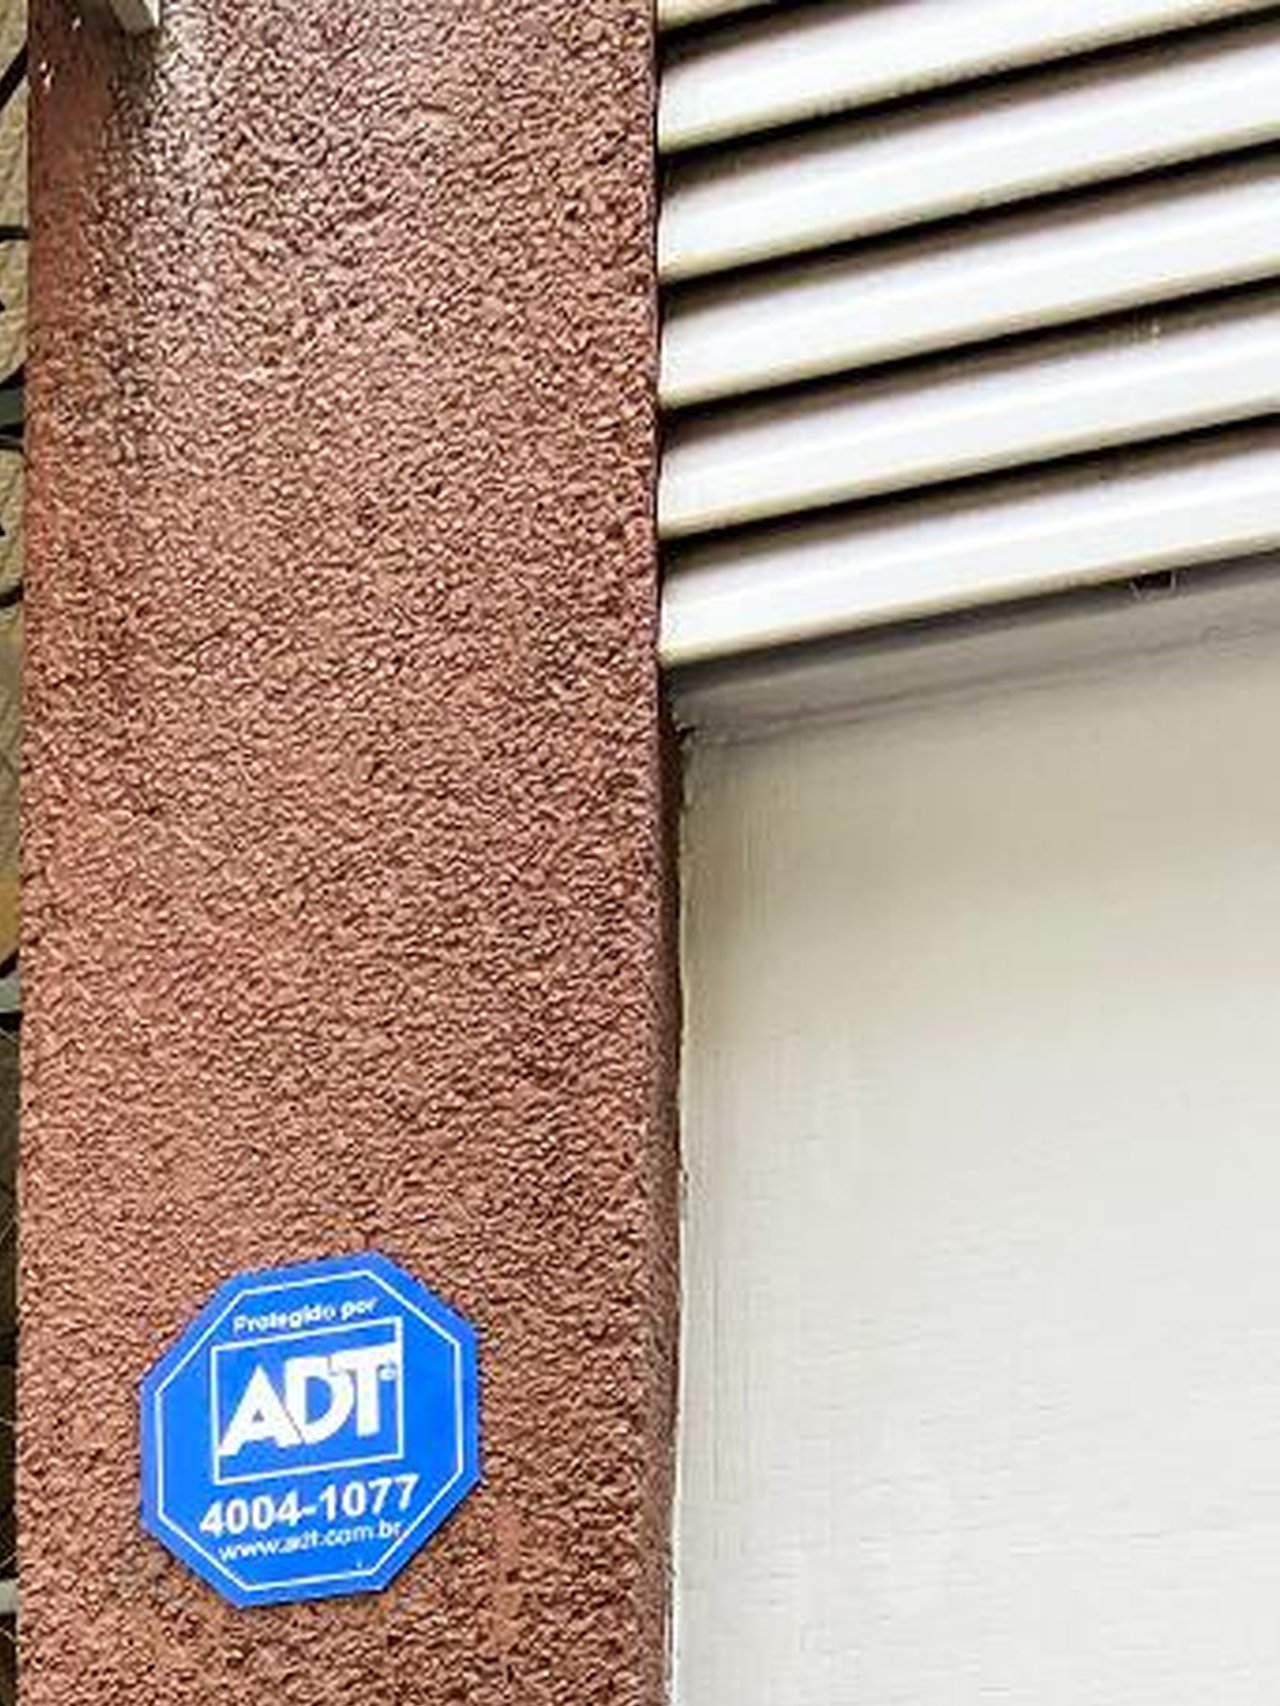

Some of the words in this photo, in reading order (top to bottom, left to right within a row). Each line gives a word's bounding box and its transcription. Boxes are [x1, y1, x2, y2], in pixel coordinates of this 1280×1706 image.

[232, 1304, 337, 1335] Protegido
[341, 1297, 379, 1322] por
[199, 1473, 419, 1539] 4004-1077
[217, 1519, 403, 1562] www.adt.com.br
